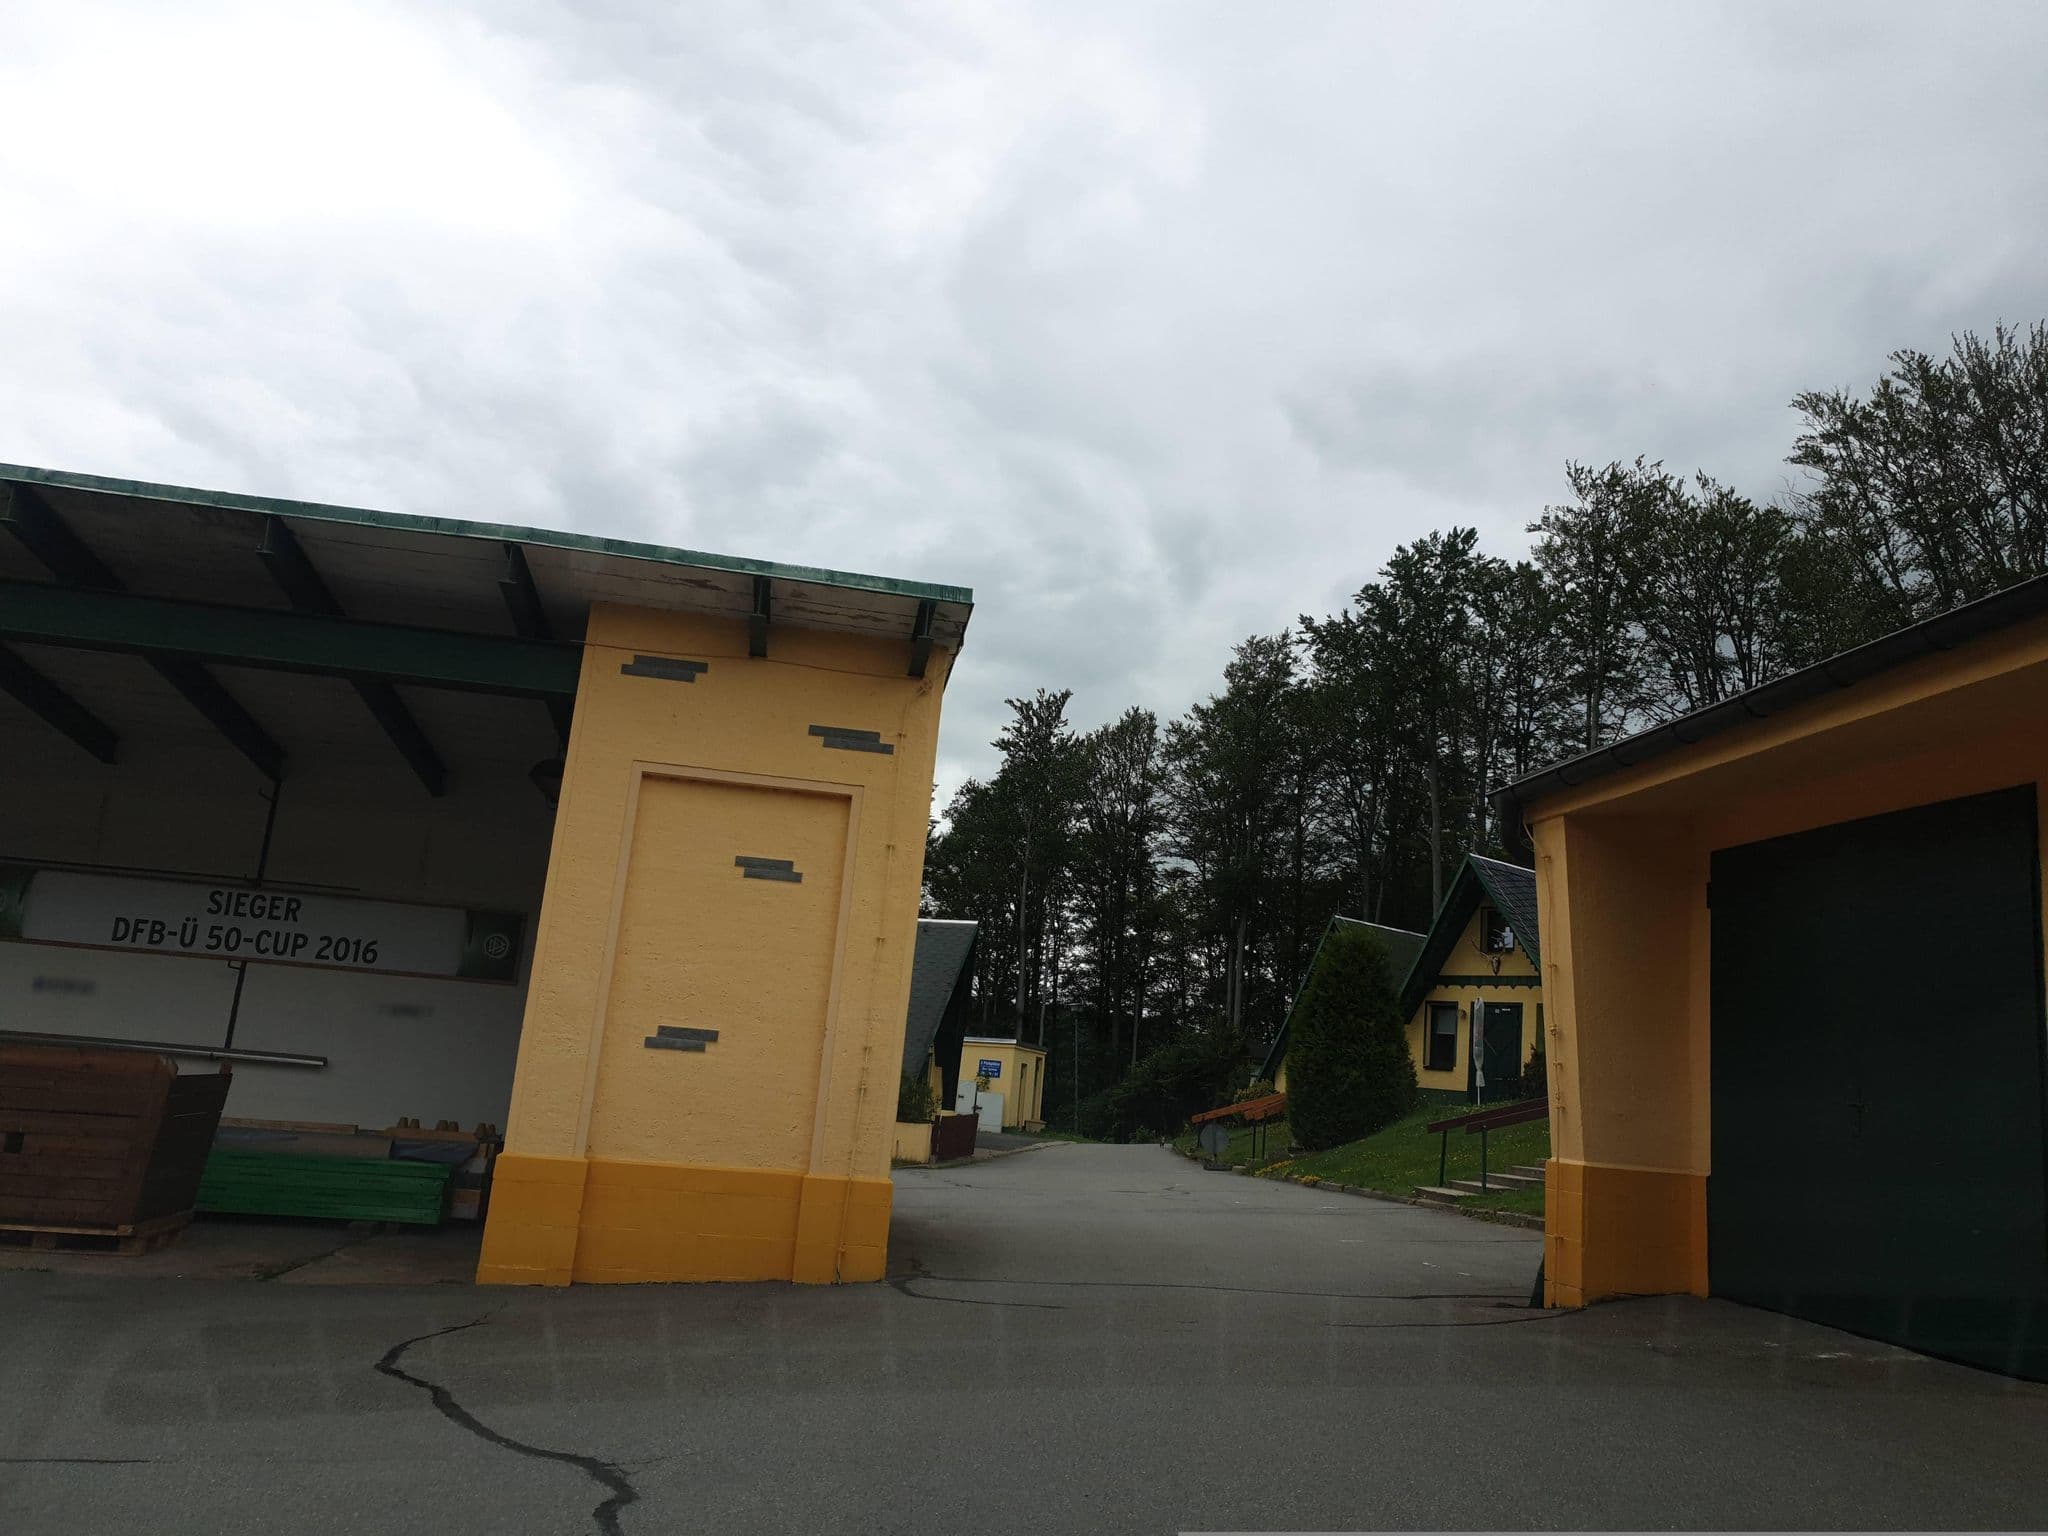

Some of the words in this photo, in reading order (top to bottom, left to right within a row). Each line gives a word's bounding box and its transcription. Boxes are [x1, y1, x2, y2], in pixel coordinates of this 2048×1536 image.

[206, 890, 303, 922] SIEGER
[111, 917, 199, 948] DFB-Ü
[205, 925, 309, 958] 50-CUP
[315, 935, 379, 964] 2016
